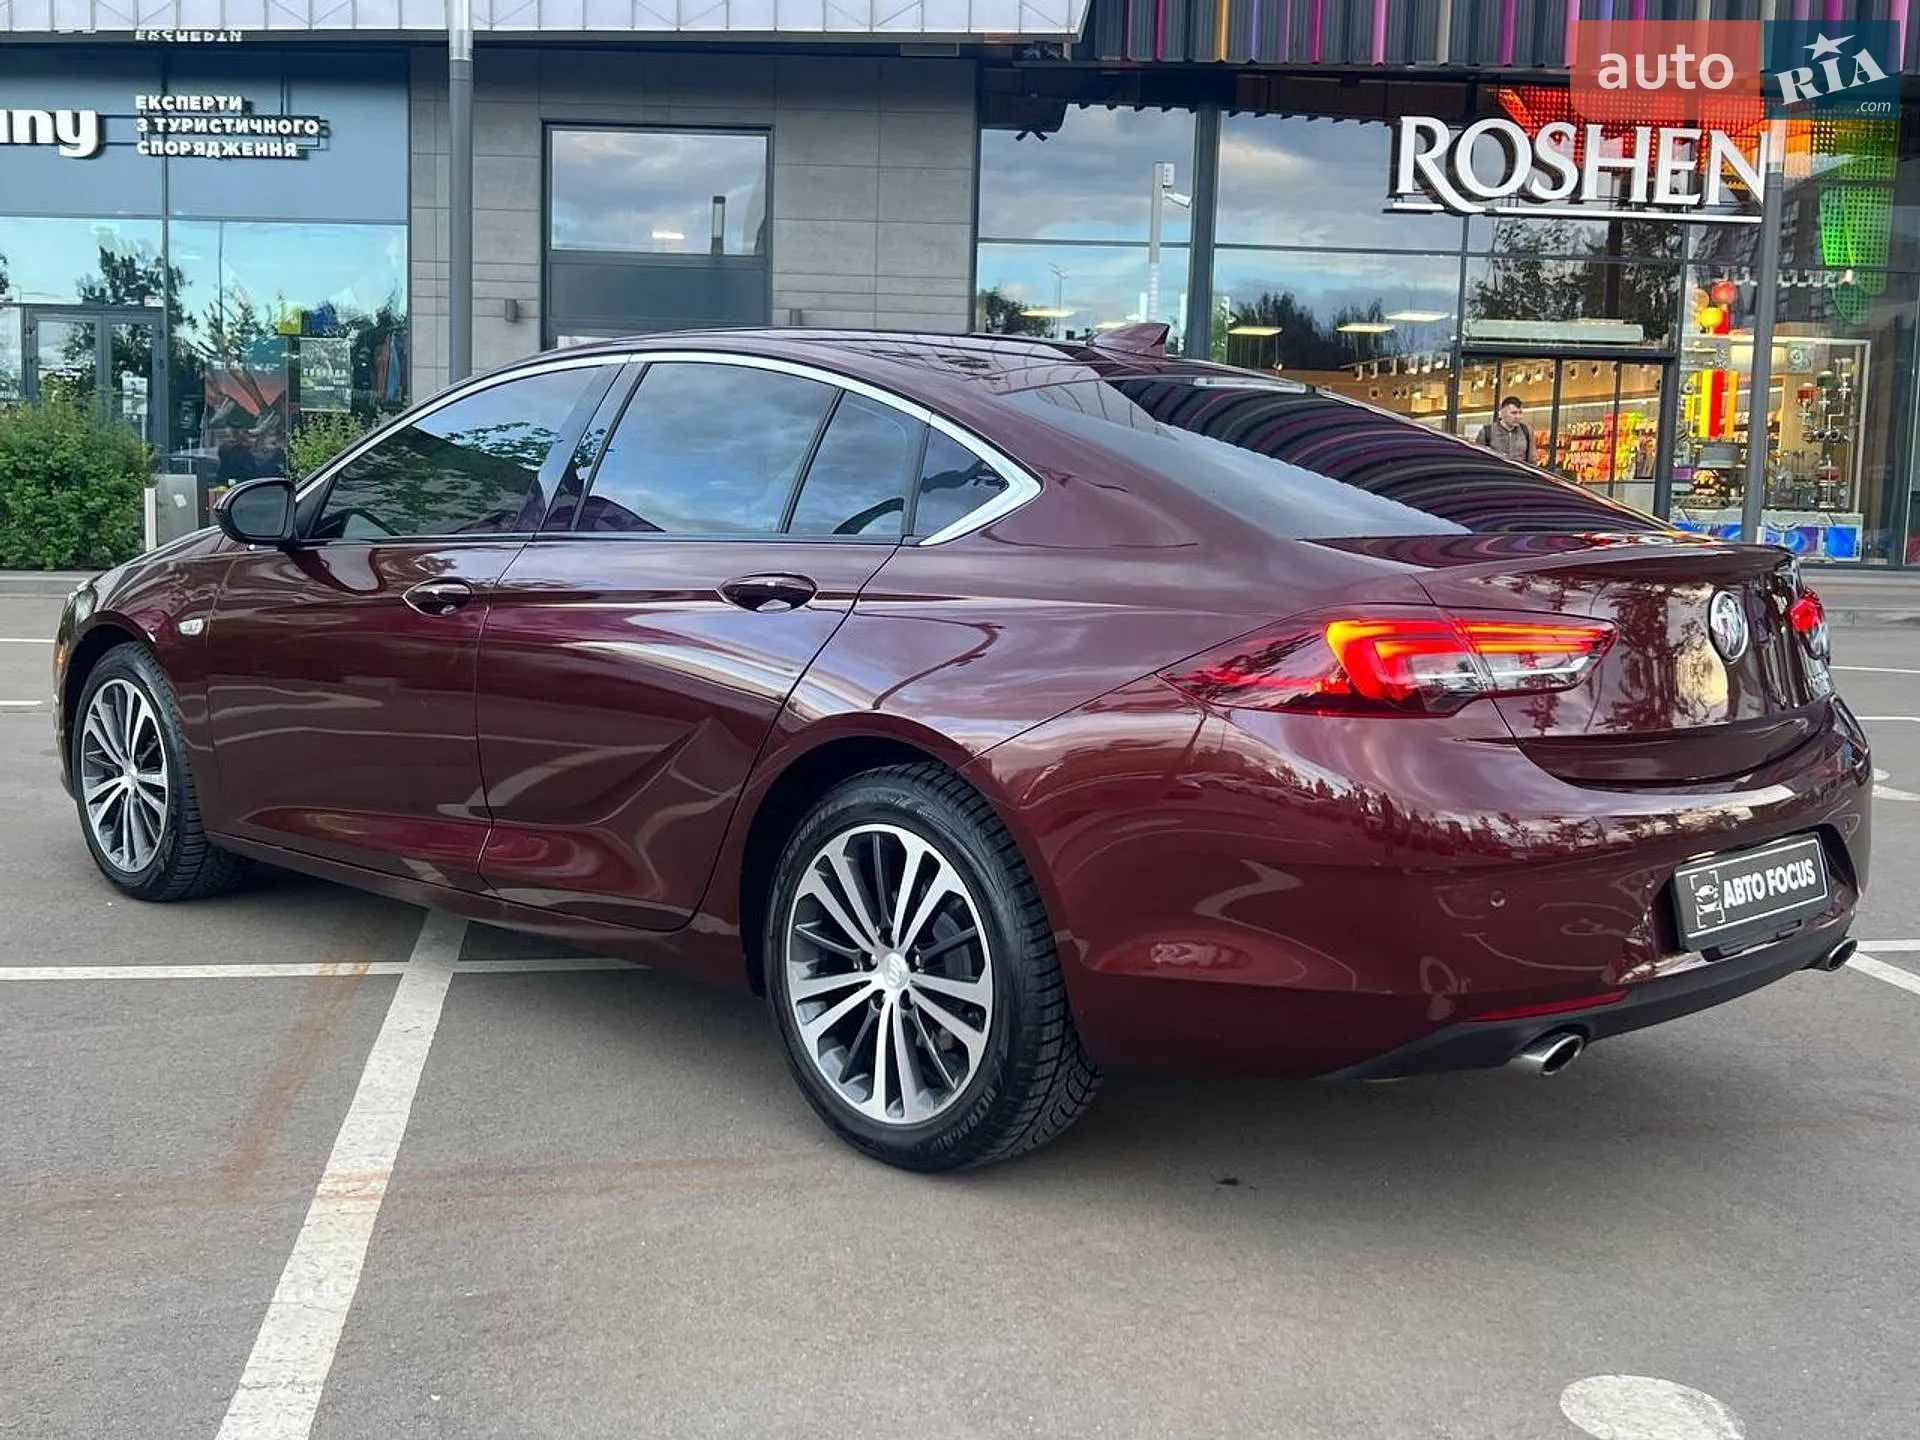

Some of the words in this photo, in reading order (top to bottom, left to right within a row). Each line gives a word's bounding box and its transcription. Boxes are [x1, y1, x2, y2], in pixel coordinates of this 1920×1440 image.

[135, 96, 243, 111] ЕКСПЕРТИ
[0, 109, 97, 158] ny
[136, 118, 148, 133] З
[155, 119, 319, 135] ТУРИСТИЧНОГО
[137, 141, 297, 158] СПОРЯДЖЕННЯ
[1396, 115, 1768, 213] ROSHEN
[1767, 858, 1816, 897] FOCUS
